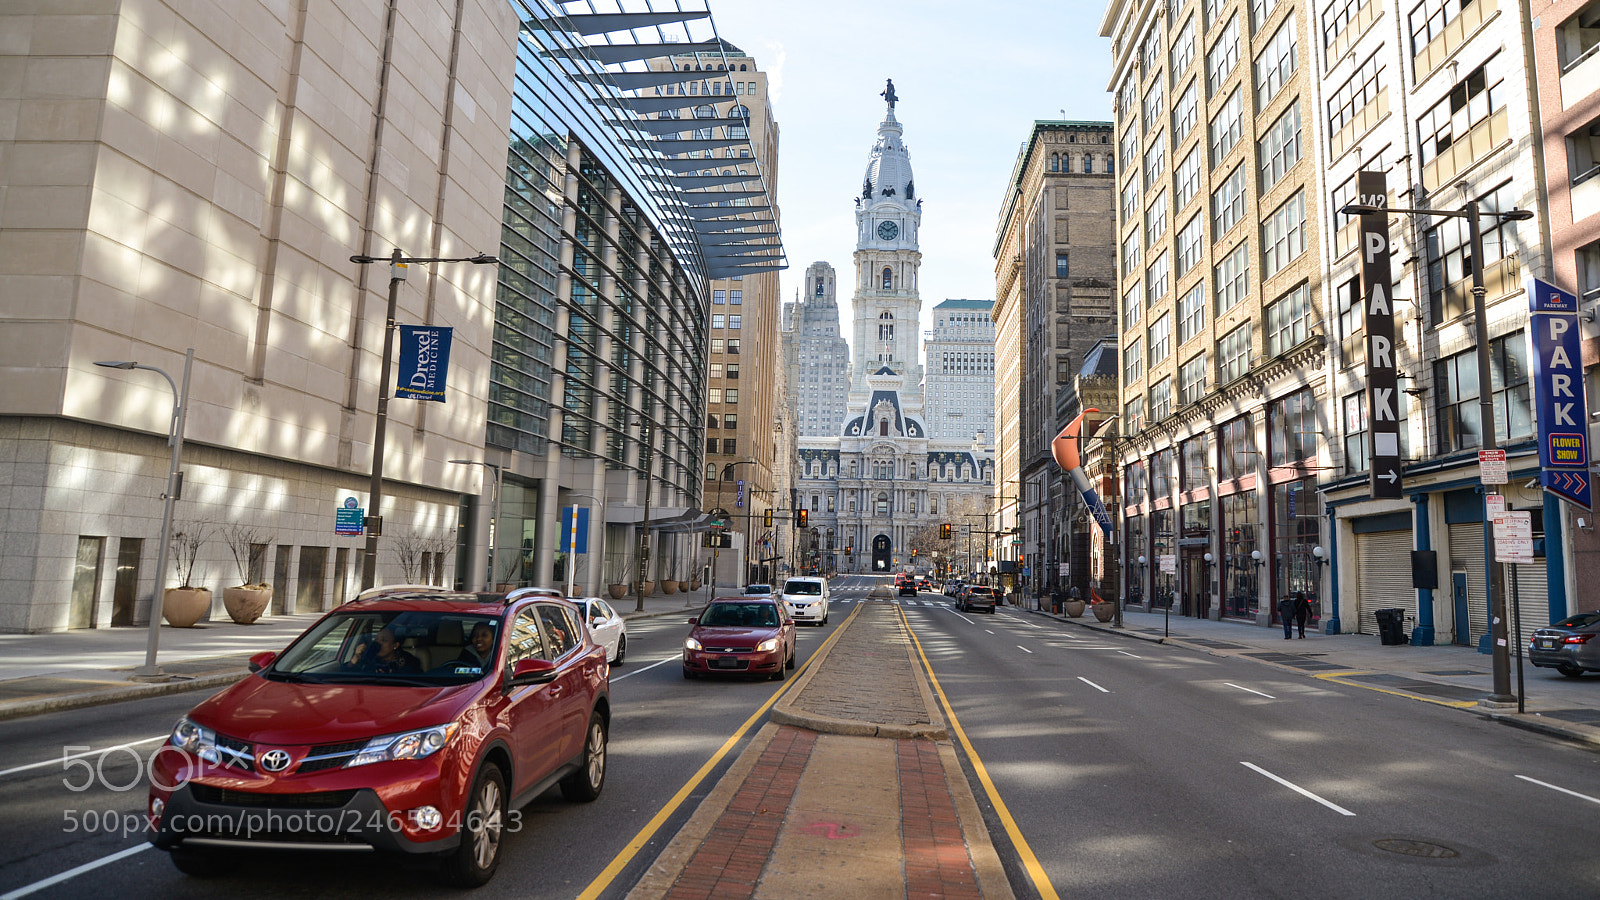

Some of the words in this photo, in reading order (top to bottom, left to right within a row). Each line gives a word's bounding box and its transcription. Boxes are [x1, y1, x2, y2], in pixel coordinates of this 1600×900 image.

[1365, 232, 1396, 421] PARK
[409, 329, 431, 389] Drexel
[427, 330, 439, 388] MEDICINE
[1549, 317, 1577, 426] PARK
[1552, 437, 1581, 448] FLOWER
[1556, 449, 1578, 460] SHOW
